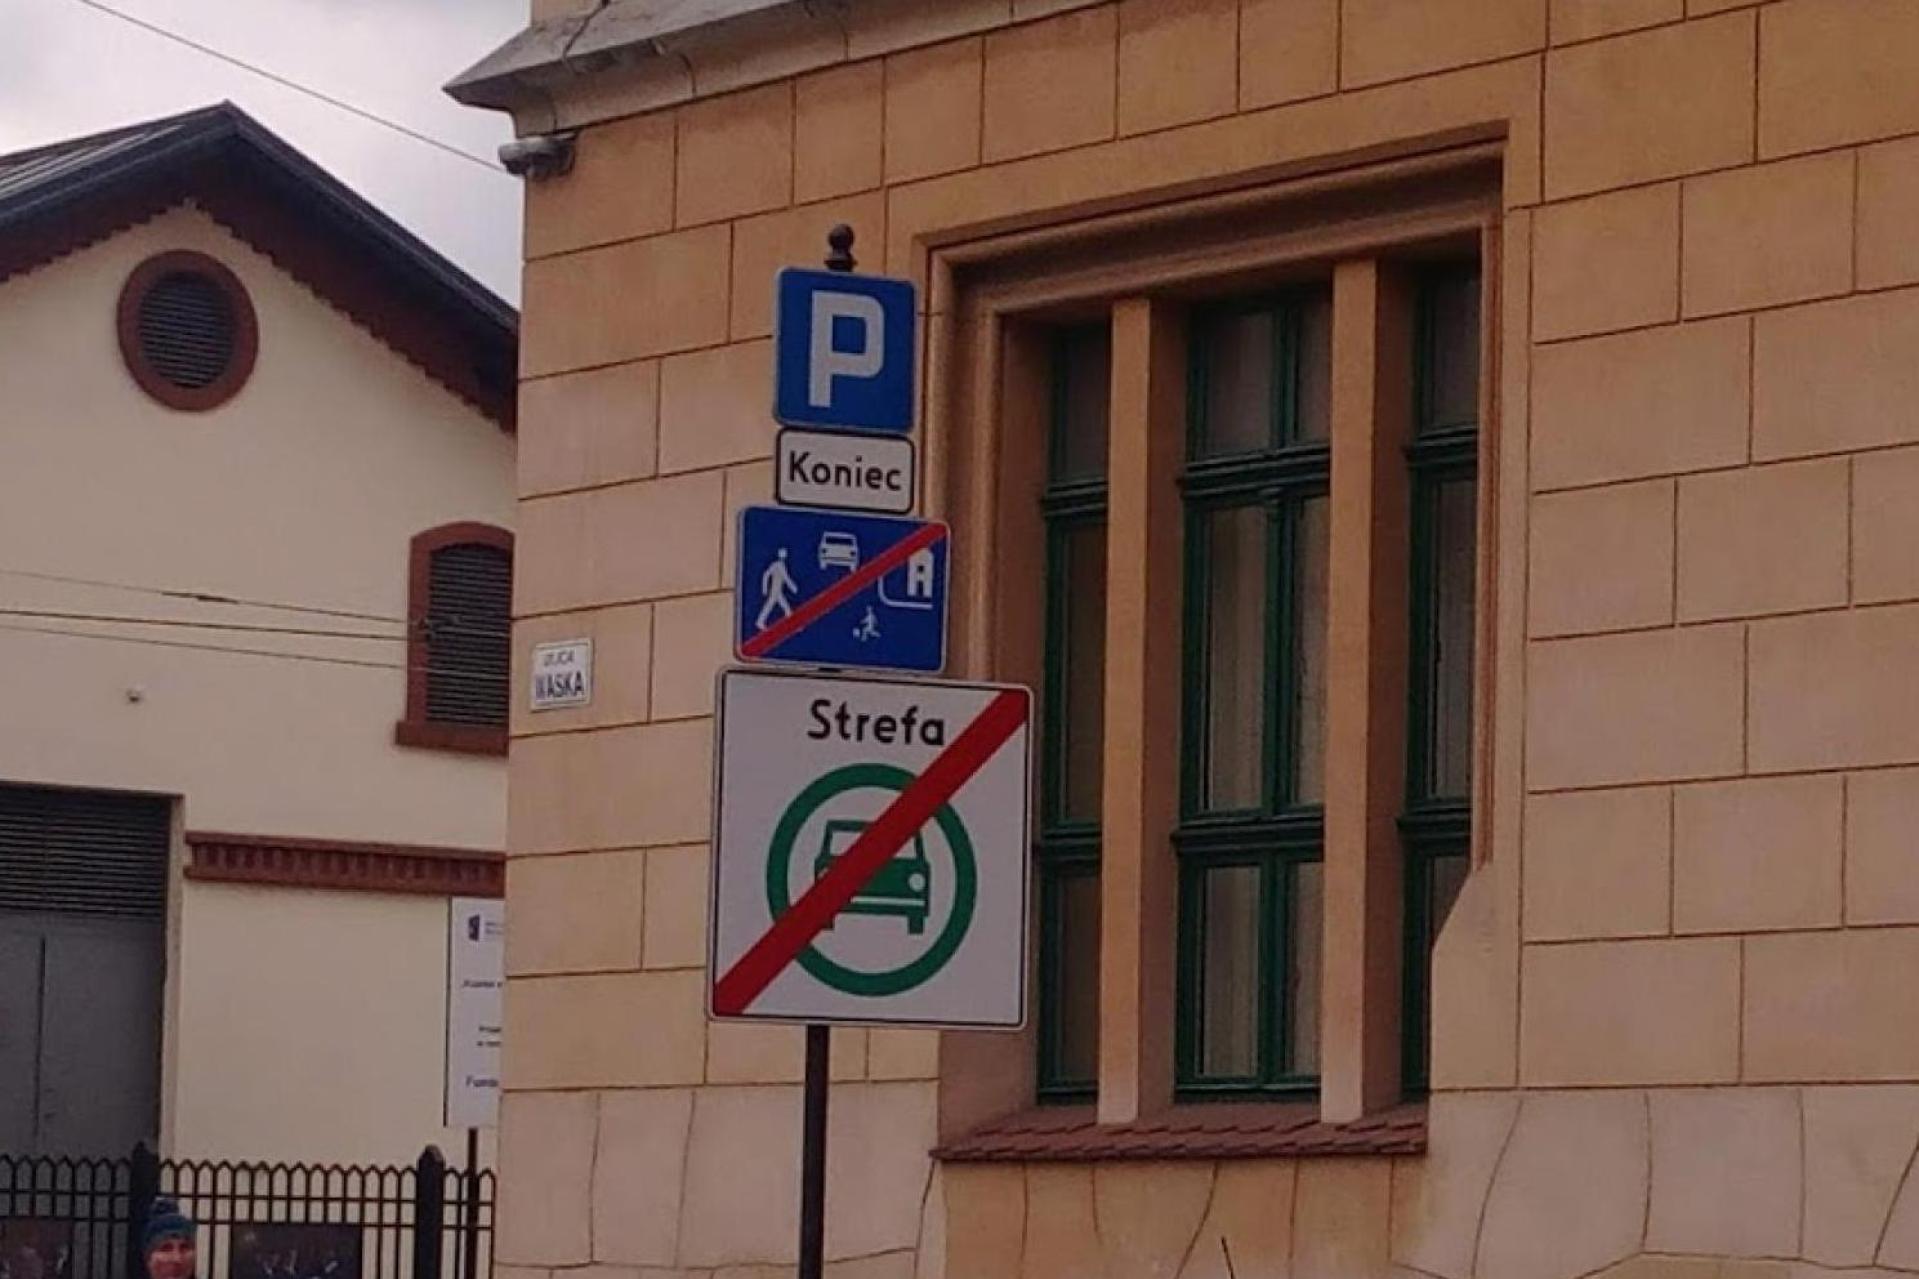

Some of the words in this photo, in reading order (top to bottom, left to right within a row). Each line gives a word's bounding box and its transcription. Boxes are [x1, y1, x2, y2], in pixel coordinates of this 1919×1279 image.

[808, 289, 885, 408] P
[788, 449, 902, 492] Koniec
[807, 699, 945, 746] Strefa
